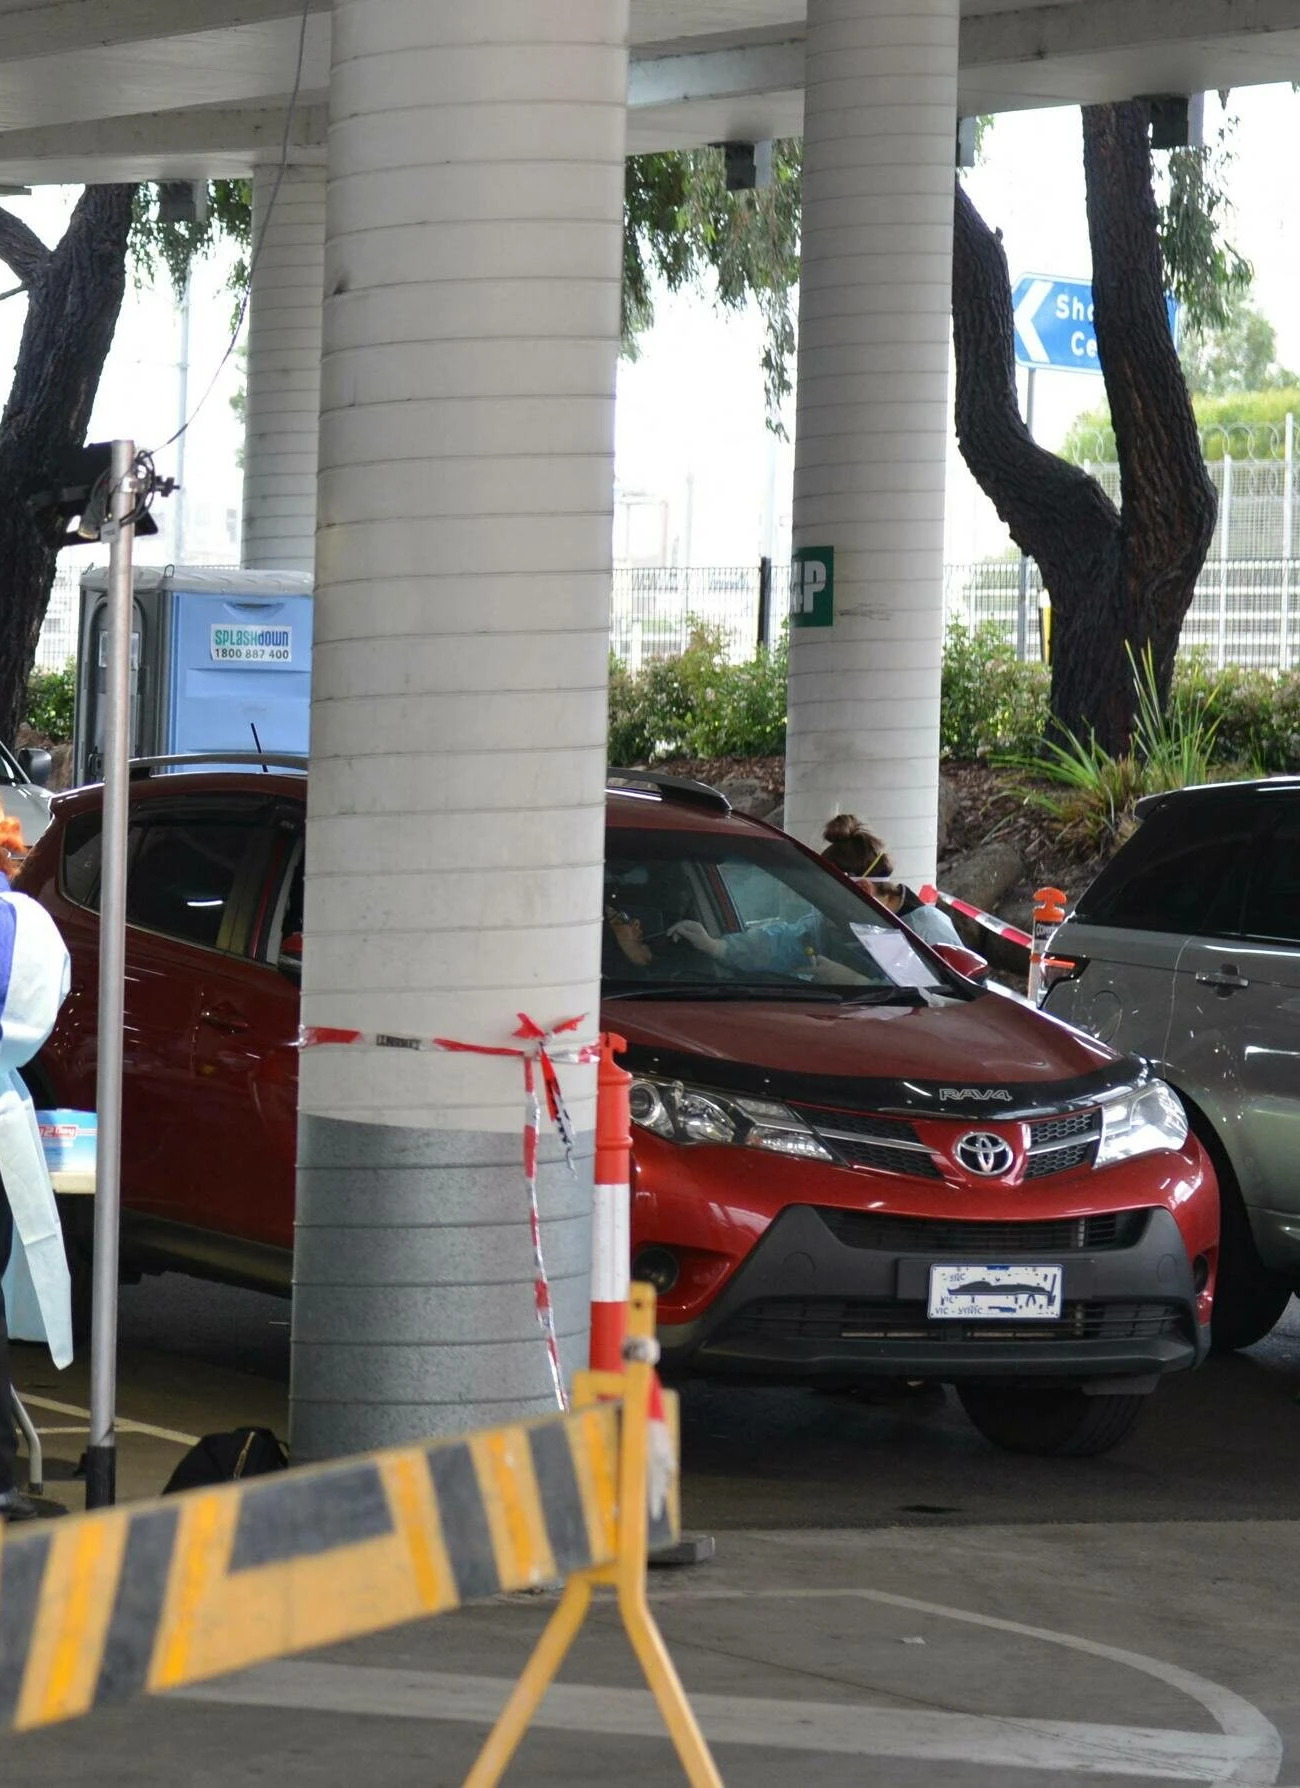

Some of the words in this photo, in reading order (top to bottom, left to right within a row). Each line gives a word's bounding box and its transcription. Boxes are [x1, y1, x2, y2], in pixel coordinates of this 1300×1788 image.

[215, 648, 242, 658] 1800
[269, 650, 289, 660] 400
[940, 1088, 1013, 1101] RAV4
